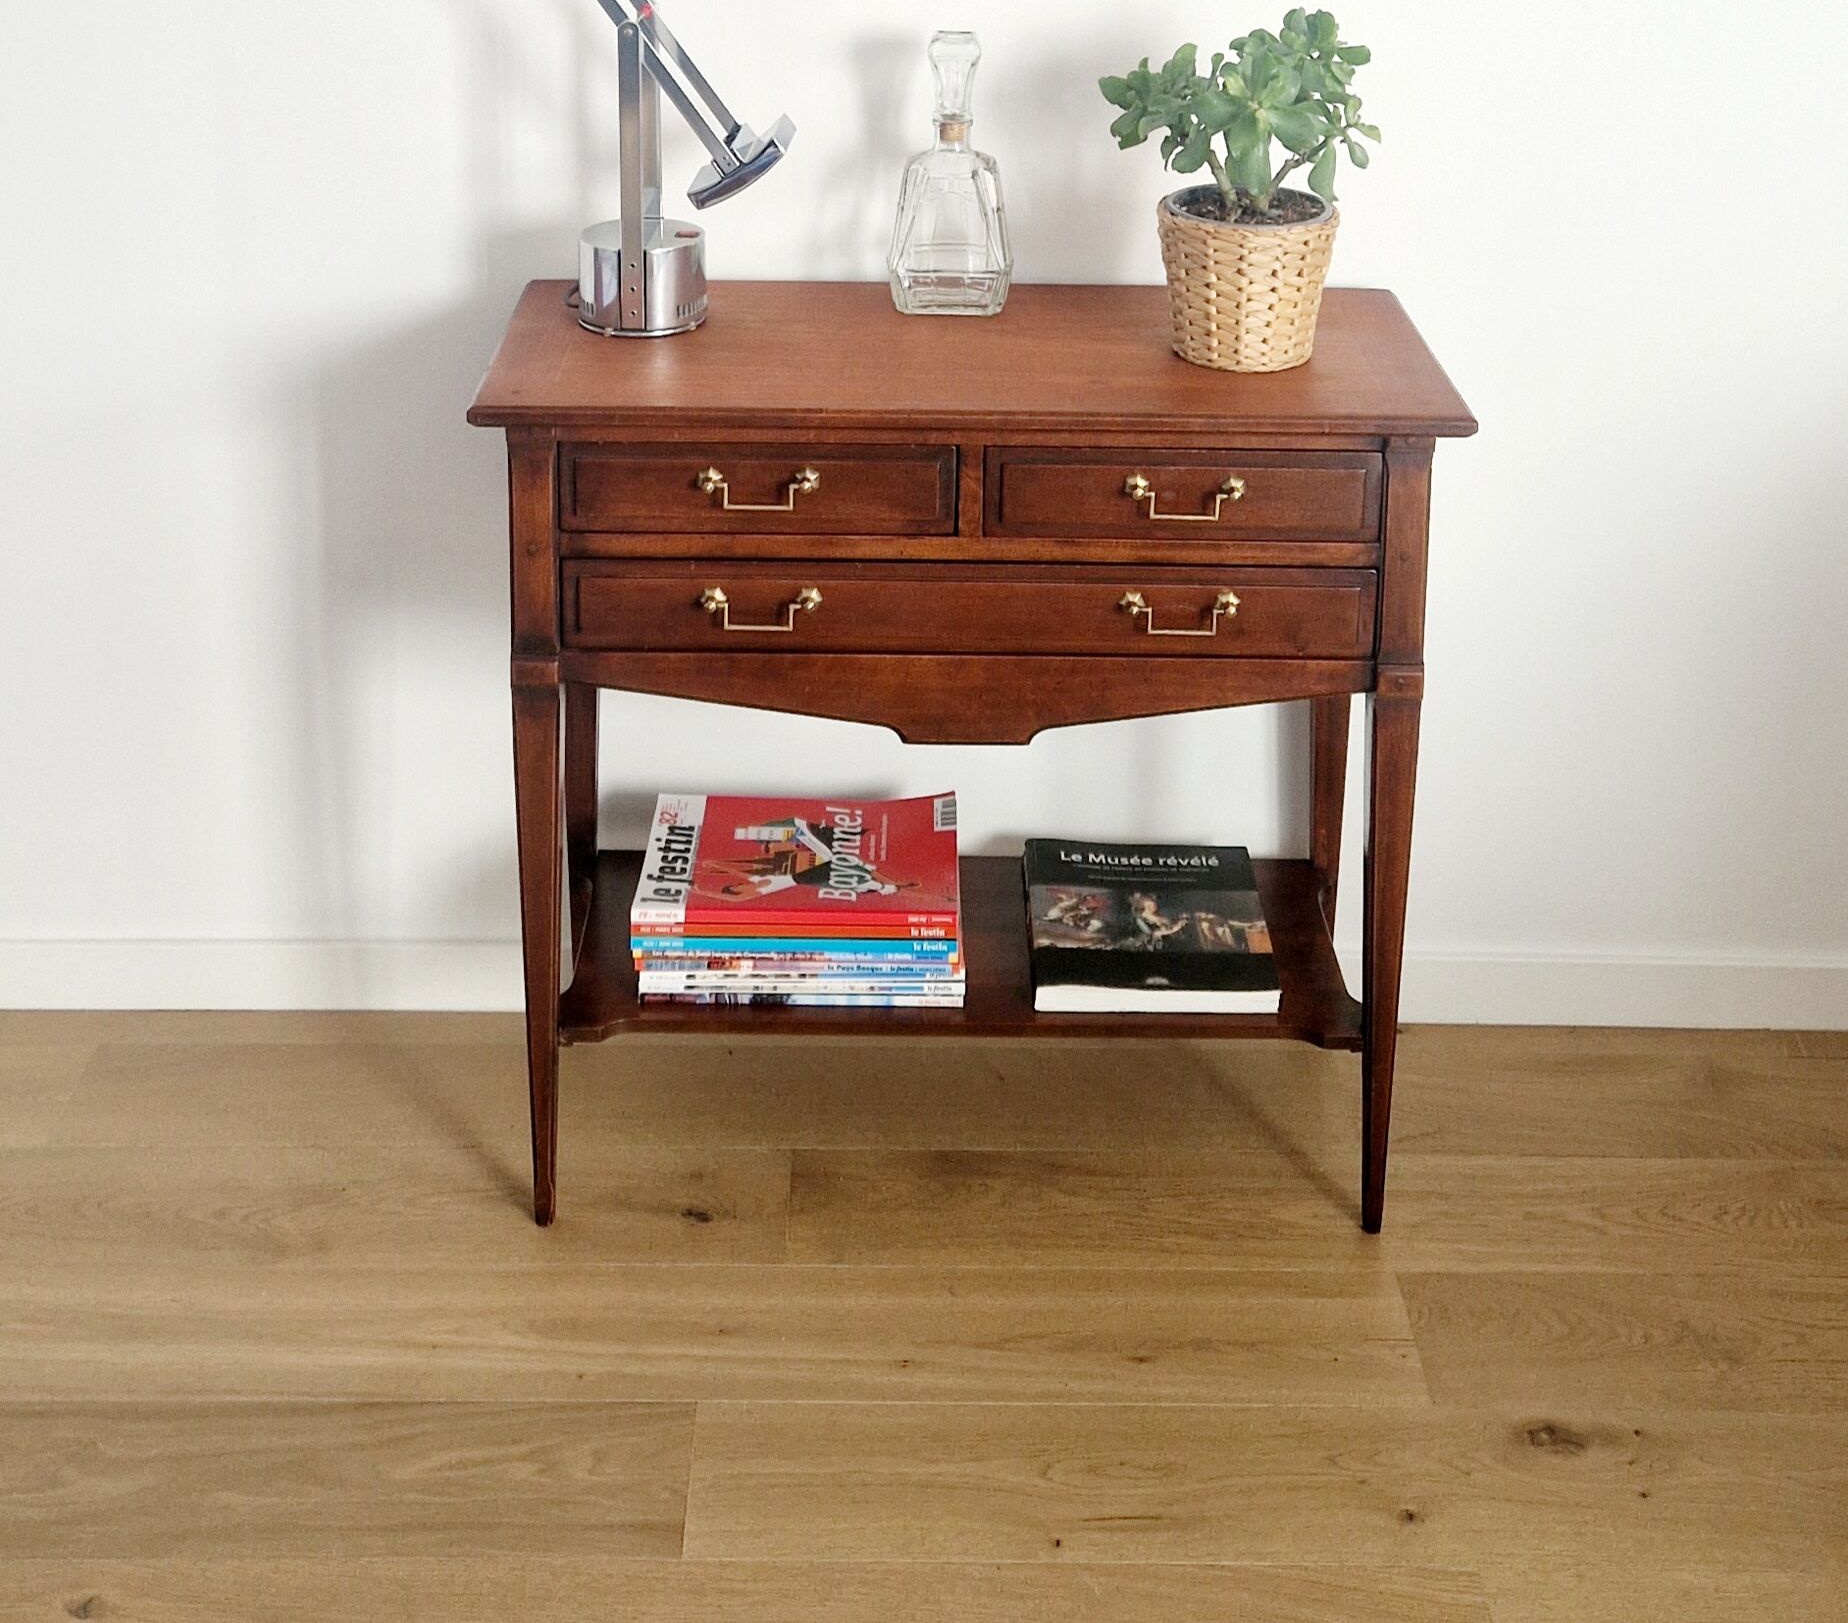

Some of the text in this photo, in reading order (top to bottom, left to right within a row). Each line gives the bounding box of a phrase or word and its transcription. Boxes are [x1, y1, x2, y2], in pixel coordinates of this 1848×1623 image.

[646, 825, 696, 886] festin
[1060, 850, 1219, 867] Le Musée révélé
[640, 887, 683, 904] le
